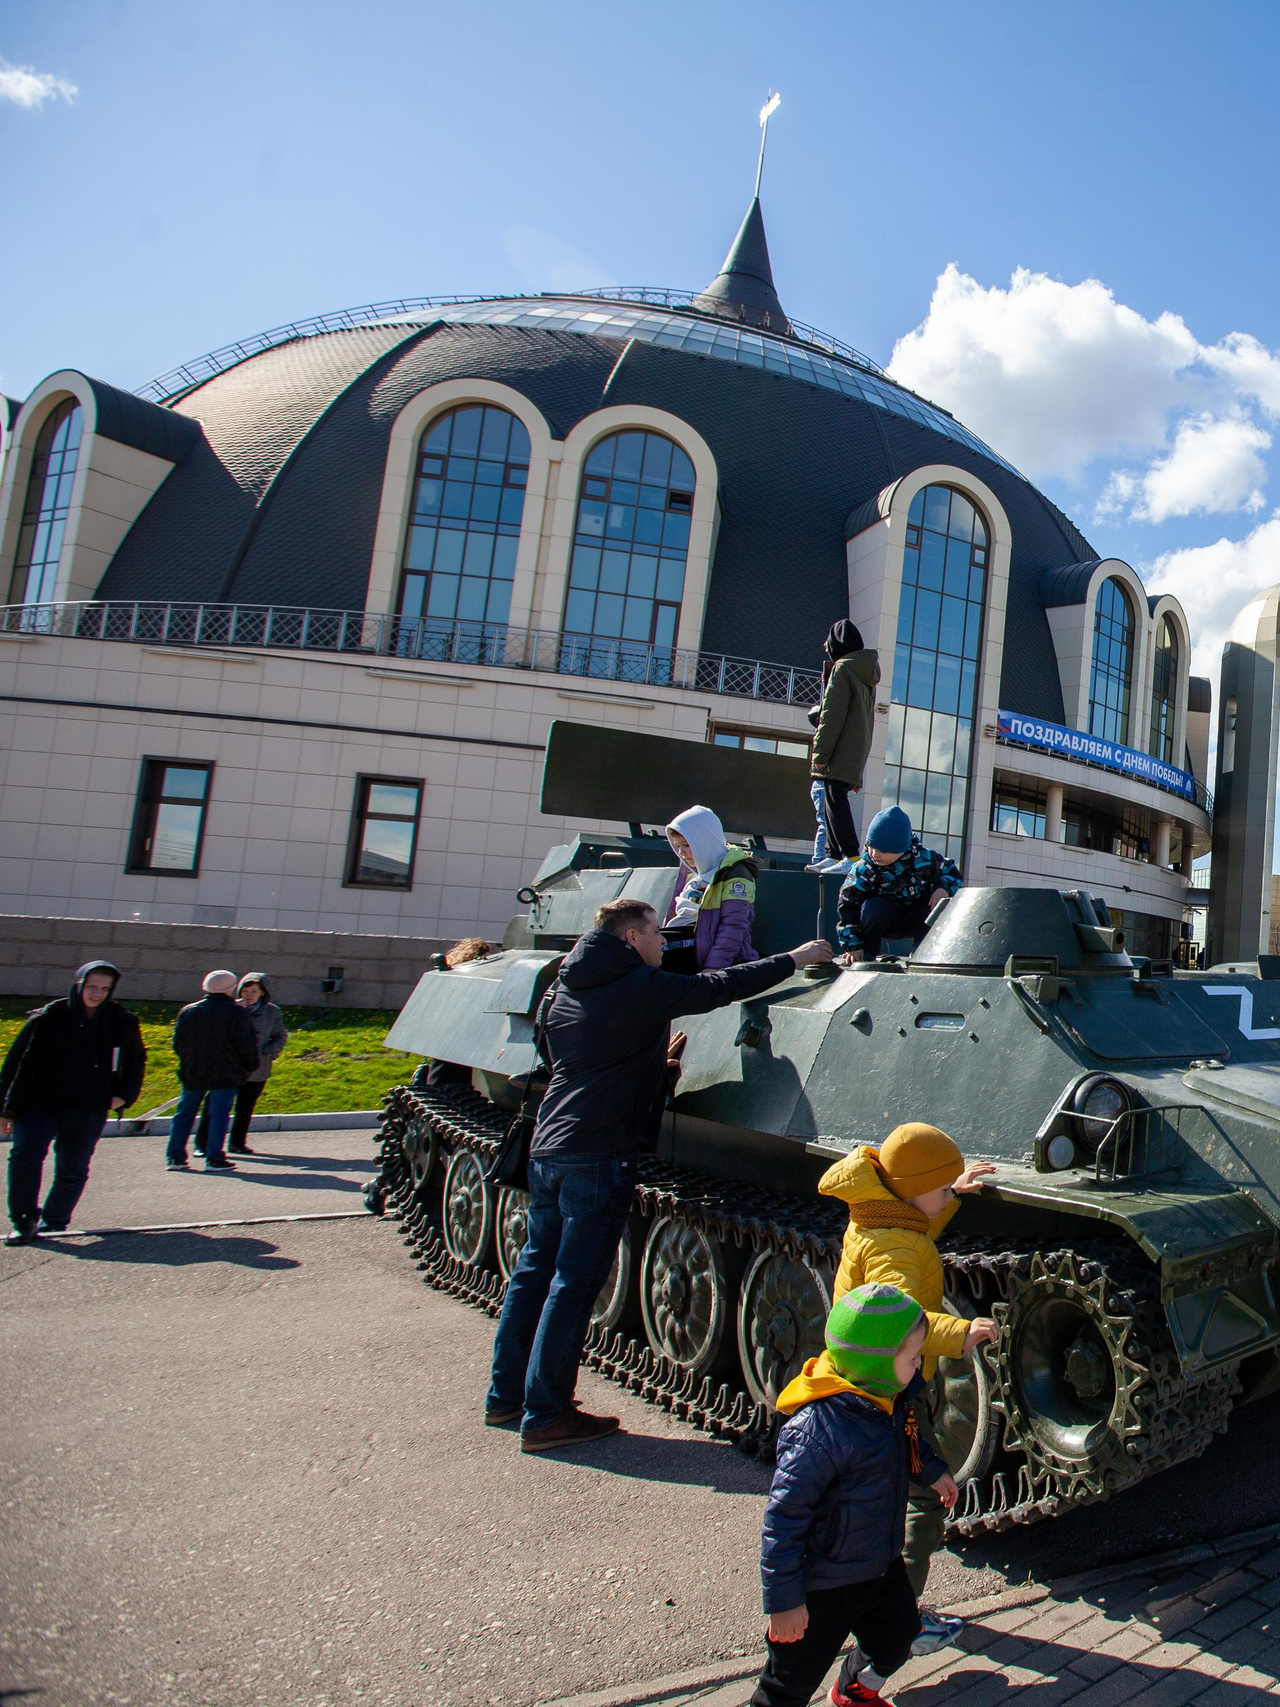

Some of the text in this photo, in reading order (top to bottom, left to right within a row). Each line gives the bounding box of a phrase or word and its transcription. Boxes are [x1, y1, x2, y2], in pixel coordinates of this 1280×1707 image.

[1010, 719, 1184, 788] ПОЗДРАВЛЯЕМ С ДНЕМ ПОБЕДЫ!
